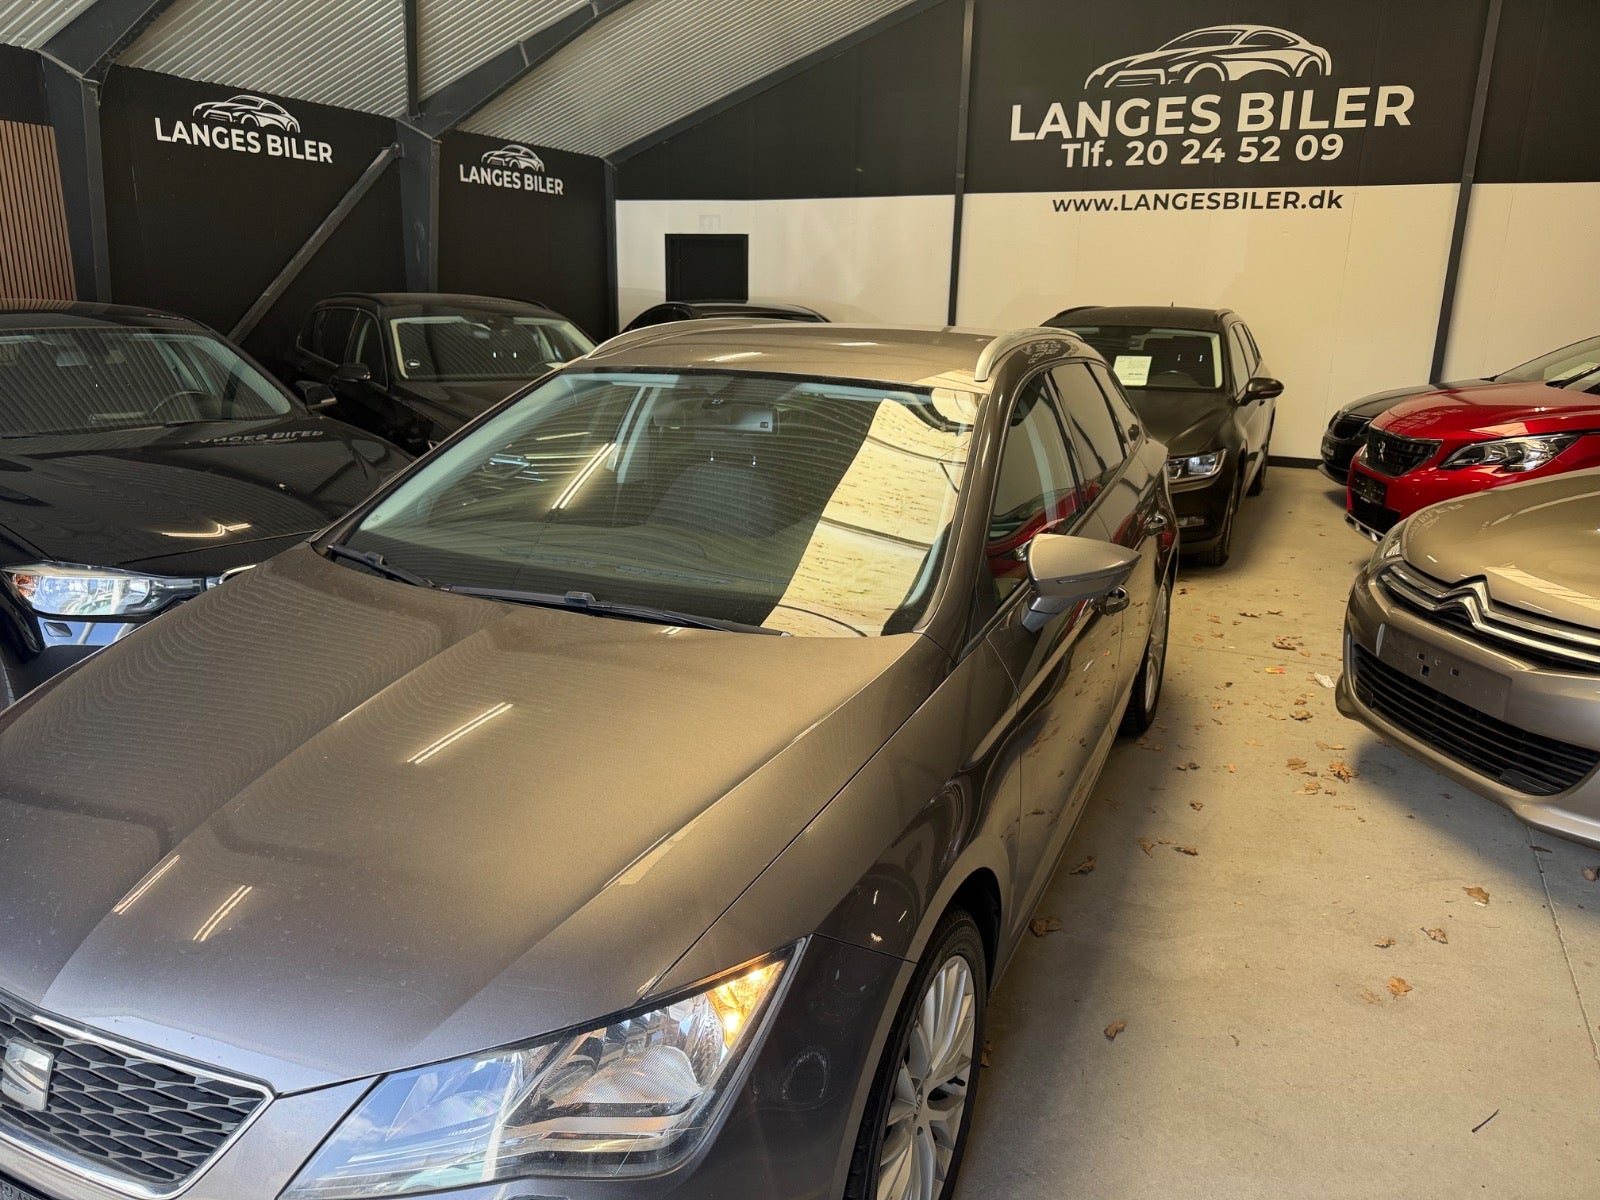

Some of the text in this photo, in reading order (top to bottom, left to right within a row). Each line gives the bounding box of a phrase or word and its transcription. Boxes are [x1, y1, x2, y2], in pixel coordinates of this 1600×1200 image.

[1010, 85, 1415, 142] LANGES BILER
[154, 117, 334, 164] LANGES BILER
[1060, 134, 1344, 168] Tlf. 20 24 52 09
[459, 163, 564, 196] LANGES BILER
[1052, 189, 1344, 213] www.LANGESBILER.dk
